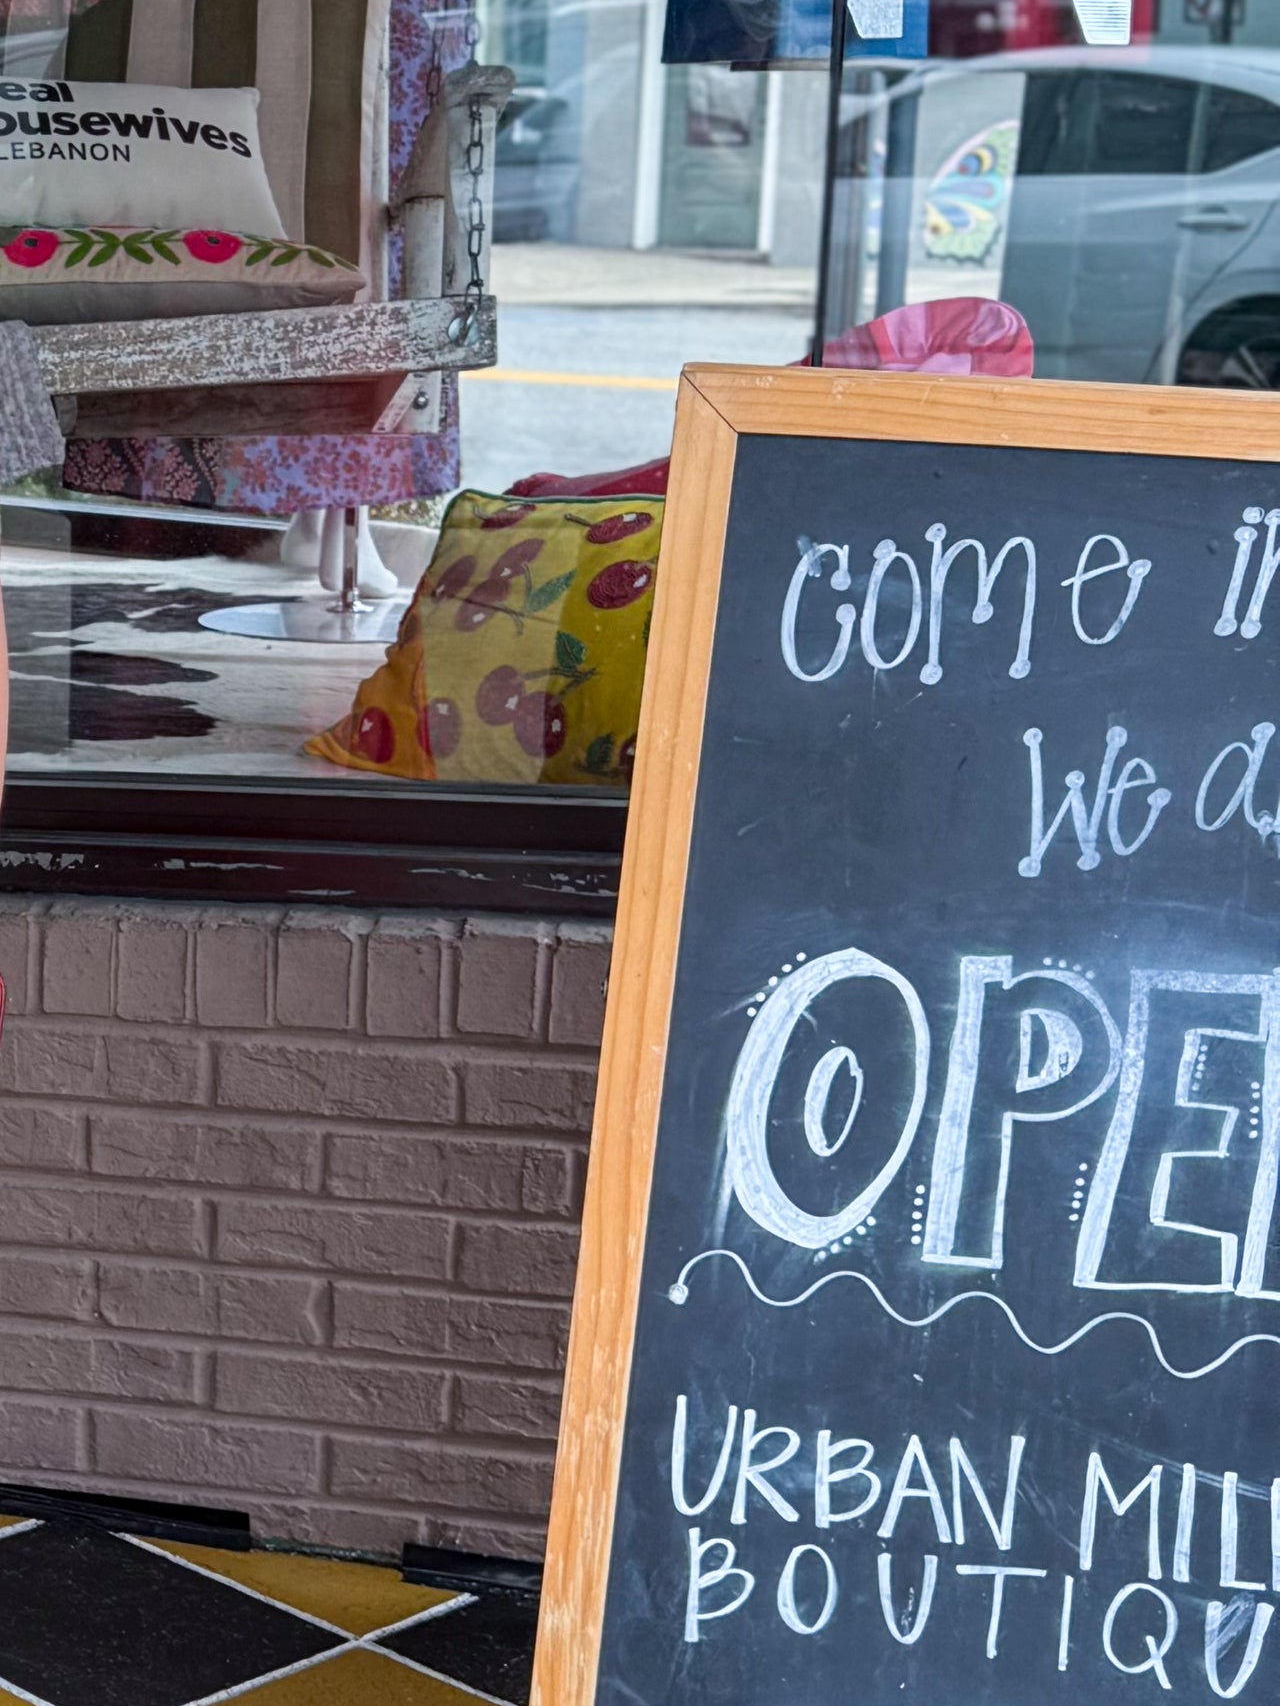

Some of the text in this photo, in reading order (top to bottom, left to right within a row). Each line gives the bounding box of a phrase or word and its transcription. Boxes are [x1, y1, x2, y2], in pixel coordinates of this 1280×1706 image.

[1195, 721, 1280, 838] a
[726, 946, 1280, 1301] OPE
[671, 1394, 1280, 1592] URBAN MIL
[684, 1526, 1276, 1699] BOUTIQU
